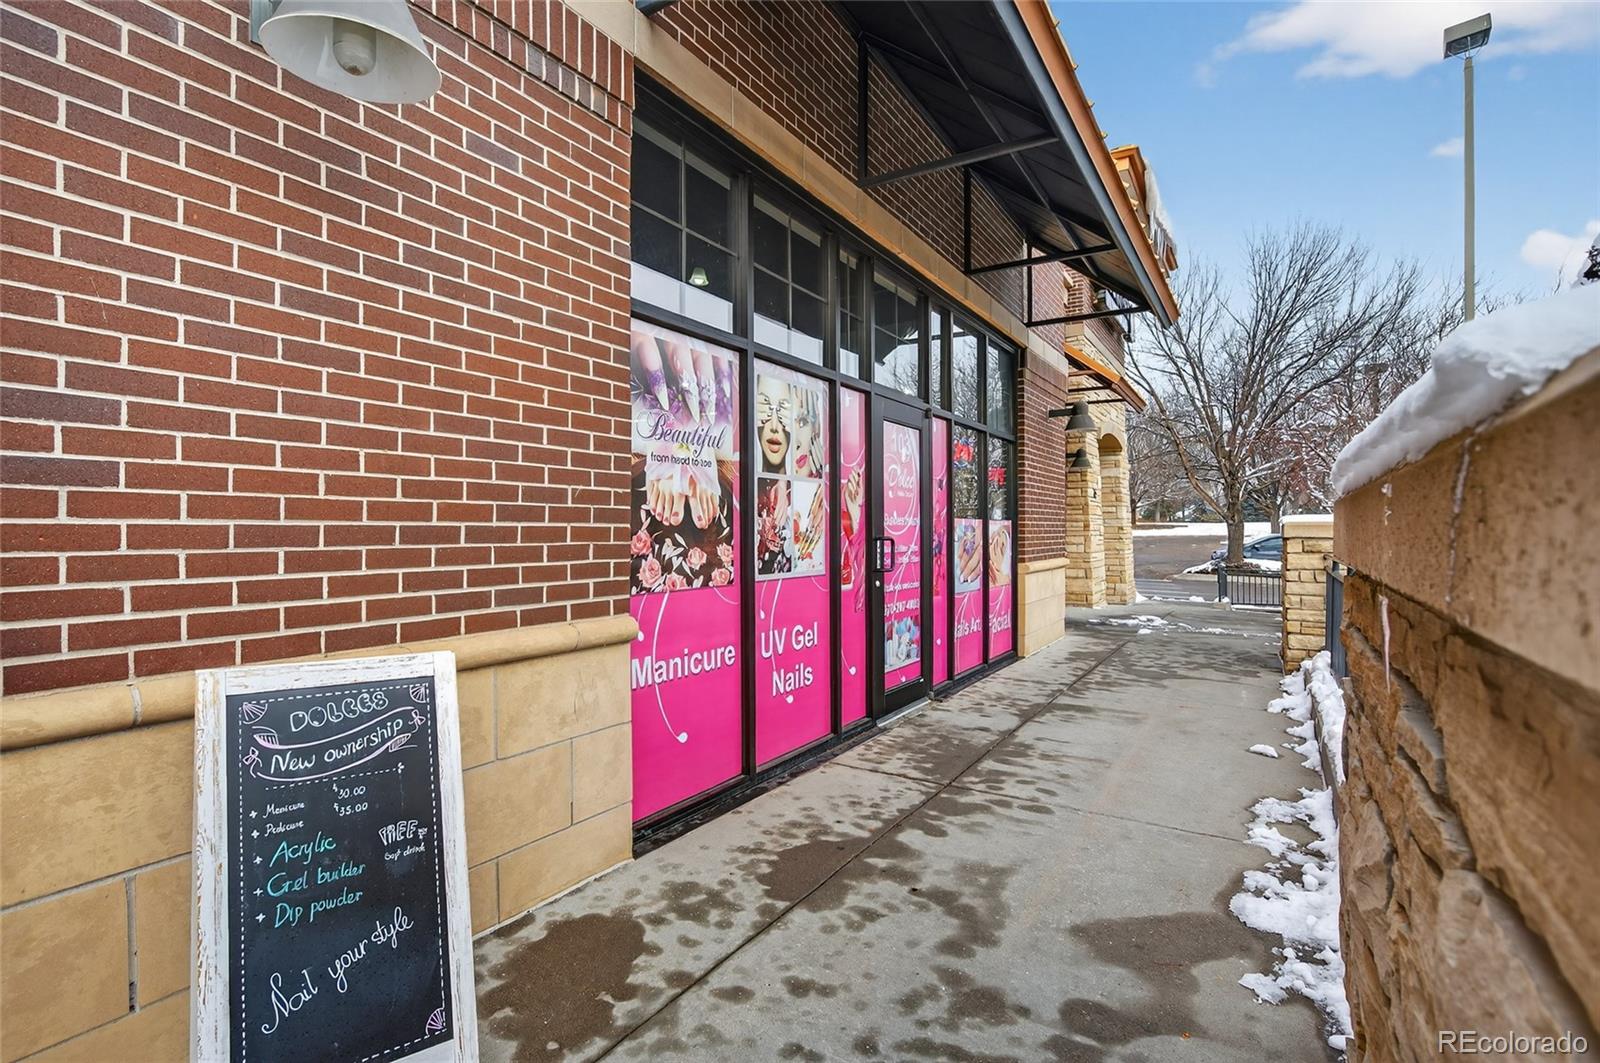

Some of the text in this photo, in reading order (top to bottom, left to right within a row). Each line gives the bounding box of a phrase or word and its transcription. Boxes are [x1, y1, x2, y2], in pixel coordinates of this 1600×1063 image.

[636, 411, 728, 458] Beautiful
[651, 451, 669, 463] from
[691, 456, 700, 467] to
[761, 621, 818, 659] UV Gel
[631, 644, 736, 690] Manicure
[772, 662, 814, 697] Nails
[270, 718, 404, 774] New ownership
[269, 831, 337, 868] Acrylic
[267, 861, 366, 897] Gel builder
[274, 886, 363, 928] Dip powder
[261, 906, 414, 1034] Nail your style
